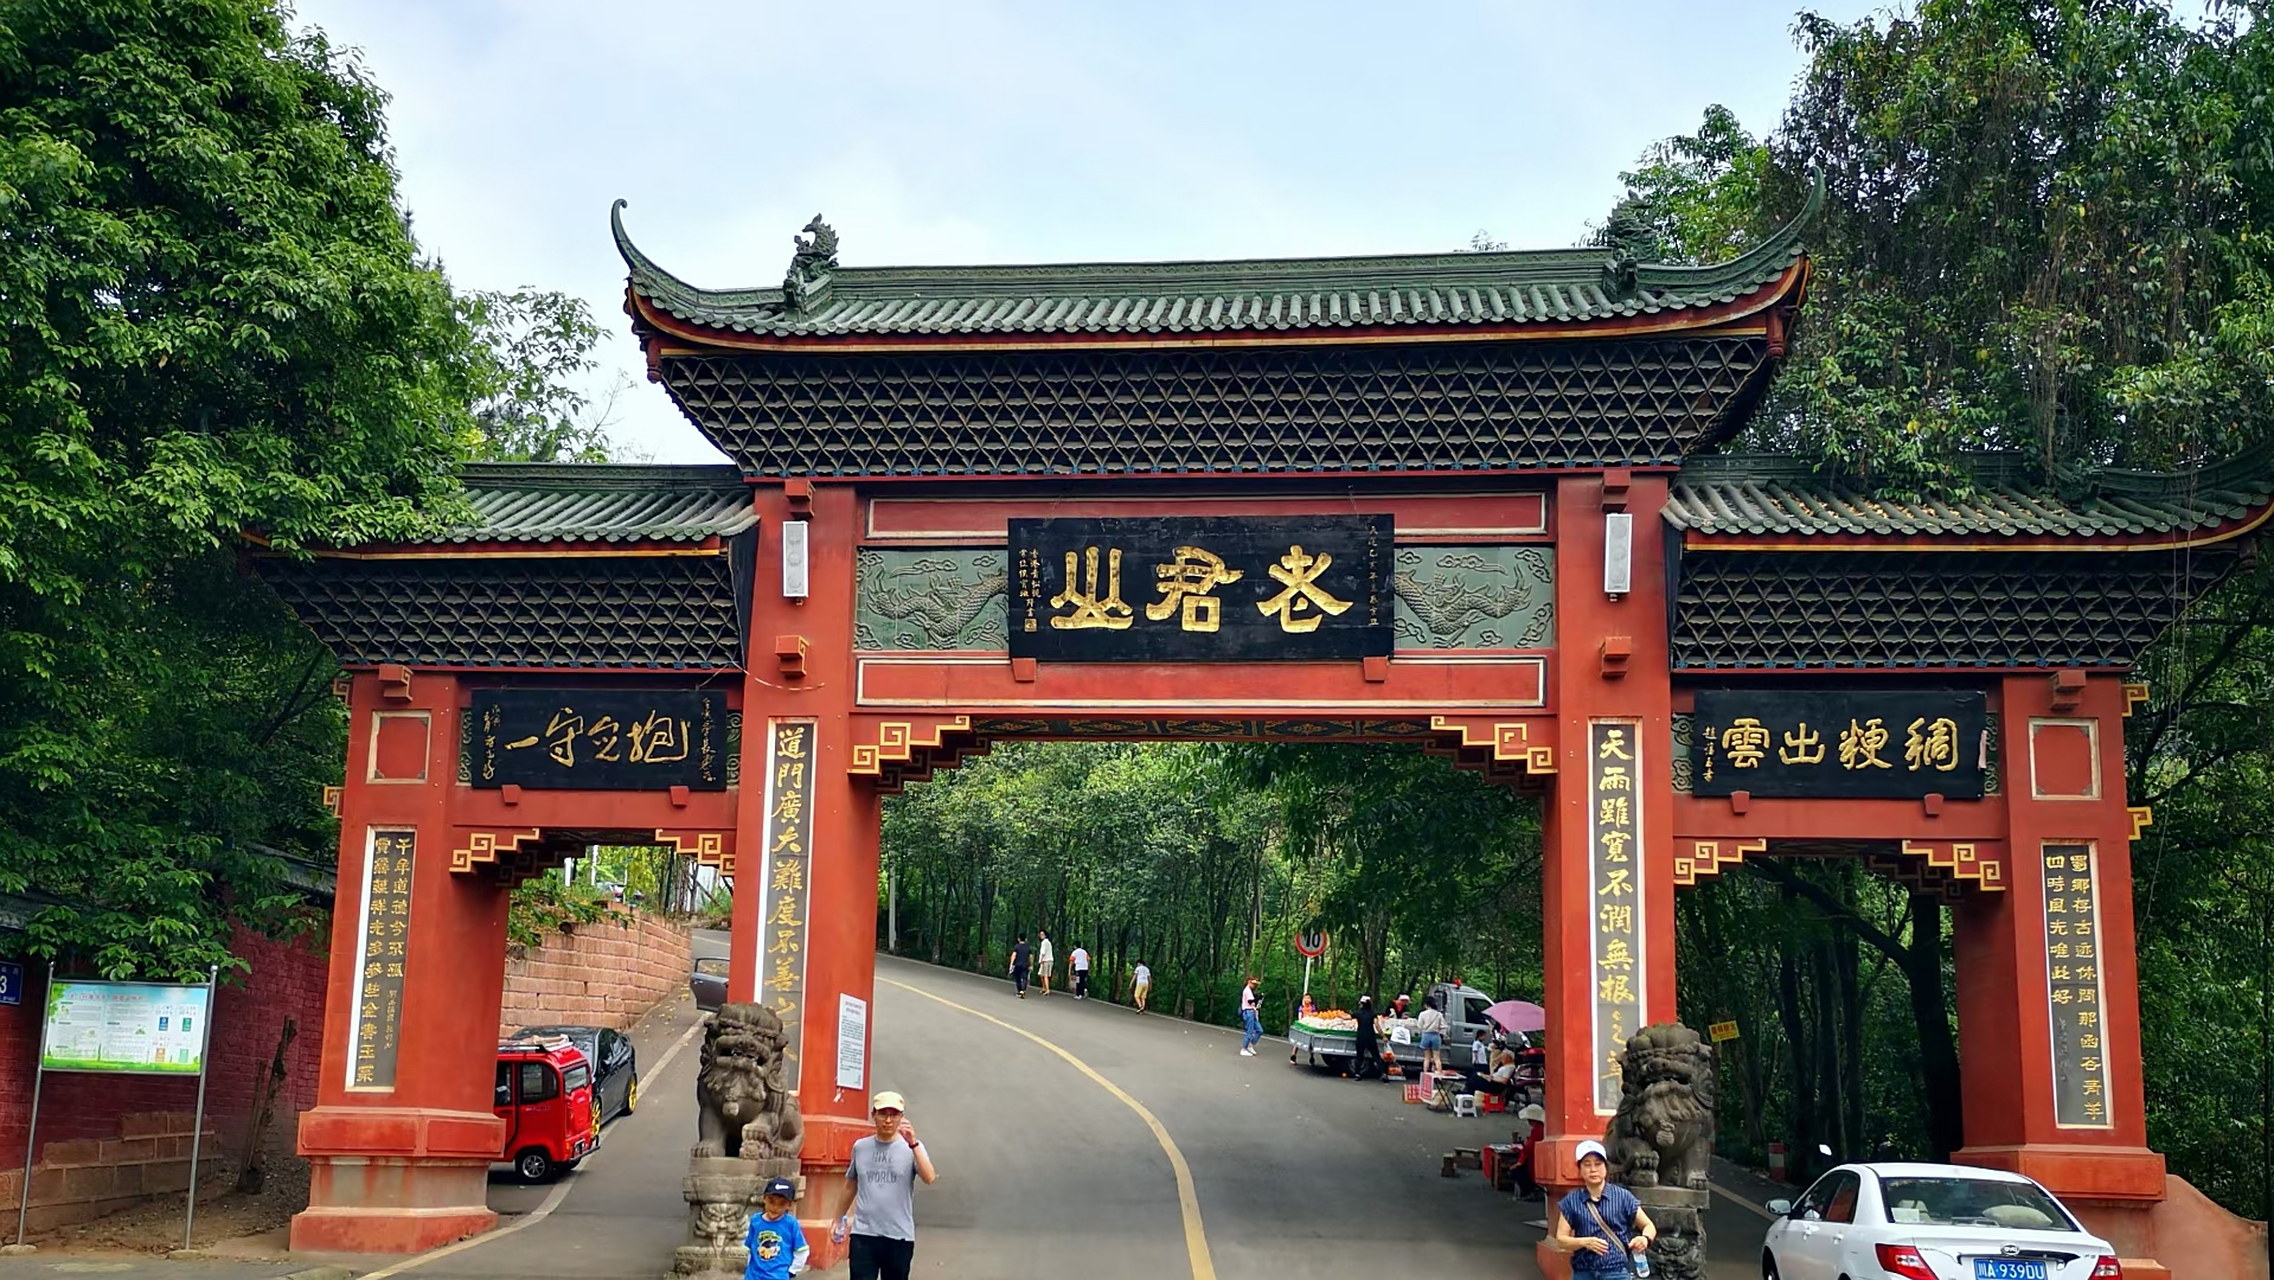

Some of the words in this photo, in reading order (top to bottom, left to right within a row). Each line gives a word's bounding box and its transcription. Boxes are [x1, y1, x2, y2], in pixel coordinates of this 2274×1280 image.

[1050, 544, 1354, 633] 老君山
[1722, 717, 1960, 771] 稠粳出雲
